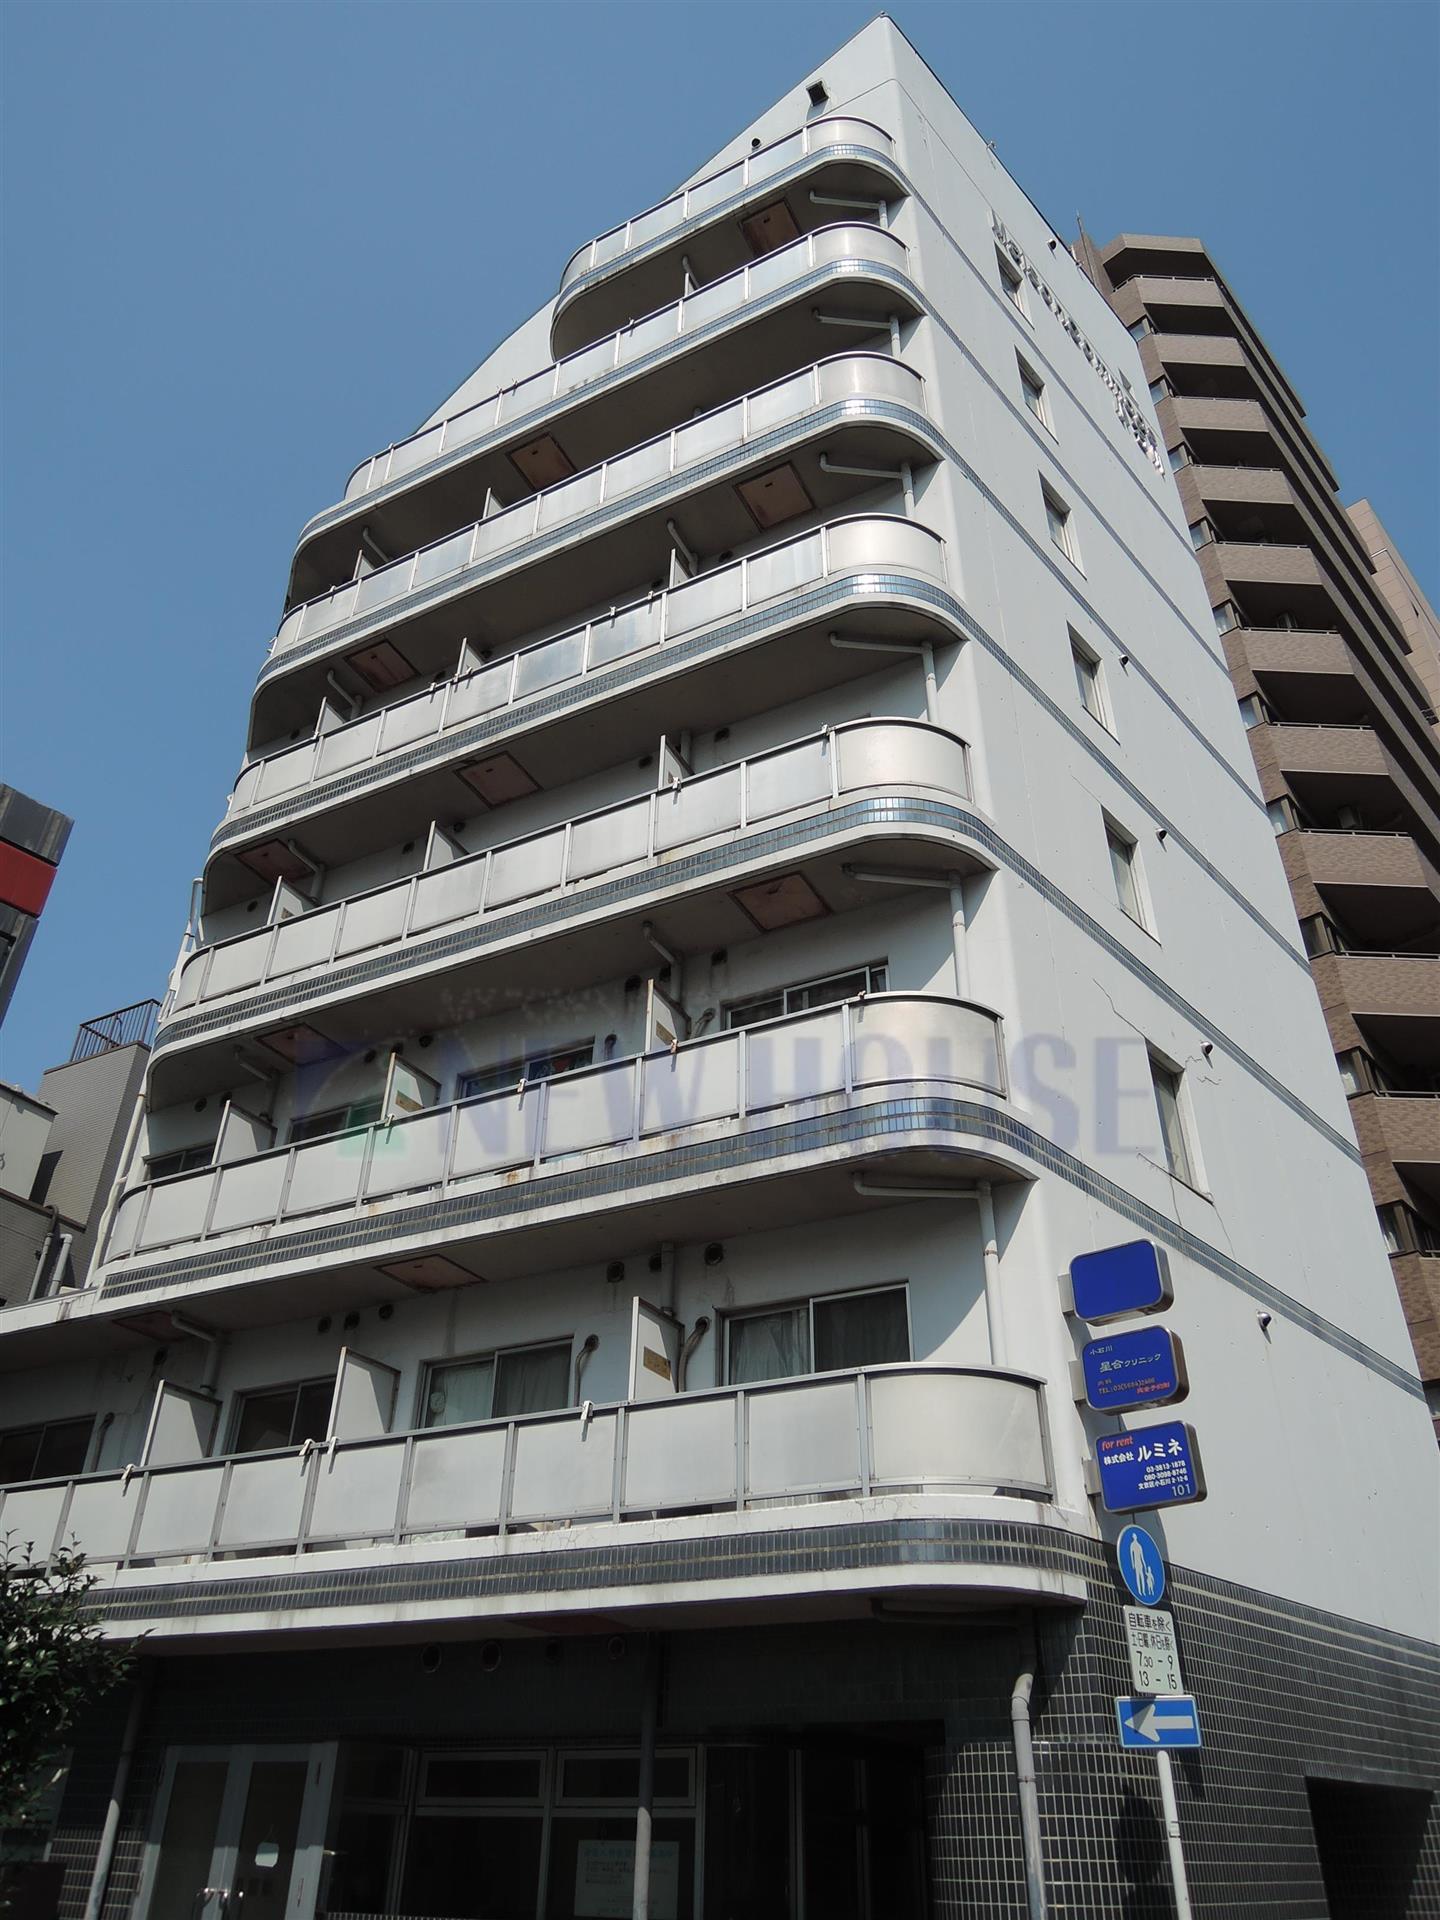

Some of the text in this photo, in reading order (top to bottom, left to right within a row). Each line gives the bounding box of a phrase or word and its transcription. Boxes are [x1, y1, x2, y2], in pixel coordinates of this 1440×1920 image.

[1089, 1345, 1112, 1355] 小石川
[1100, 1354, 1161, 1373] 星合クリニック
[1102, 1436, 1133, 1451] for rent
[1104, 1439, 1182, 1465] 株式会社 ルミネ
[1172, 1484, 1190, 1496] 101
[1129, 1612, 1171, 1631] 自転車を除く
[1139, 1670, 1149, 1686] 13
[1167, 1674, 1177, 1689] 15
